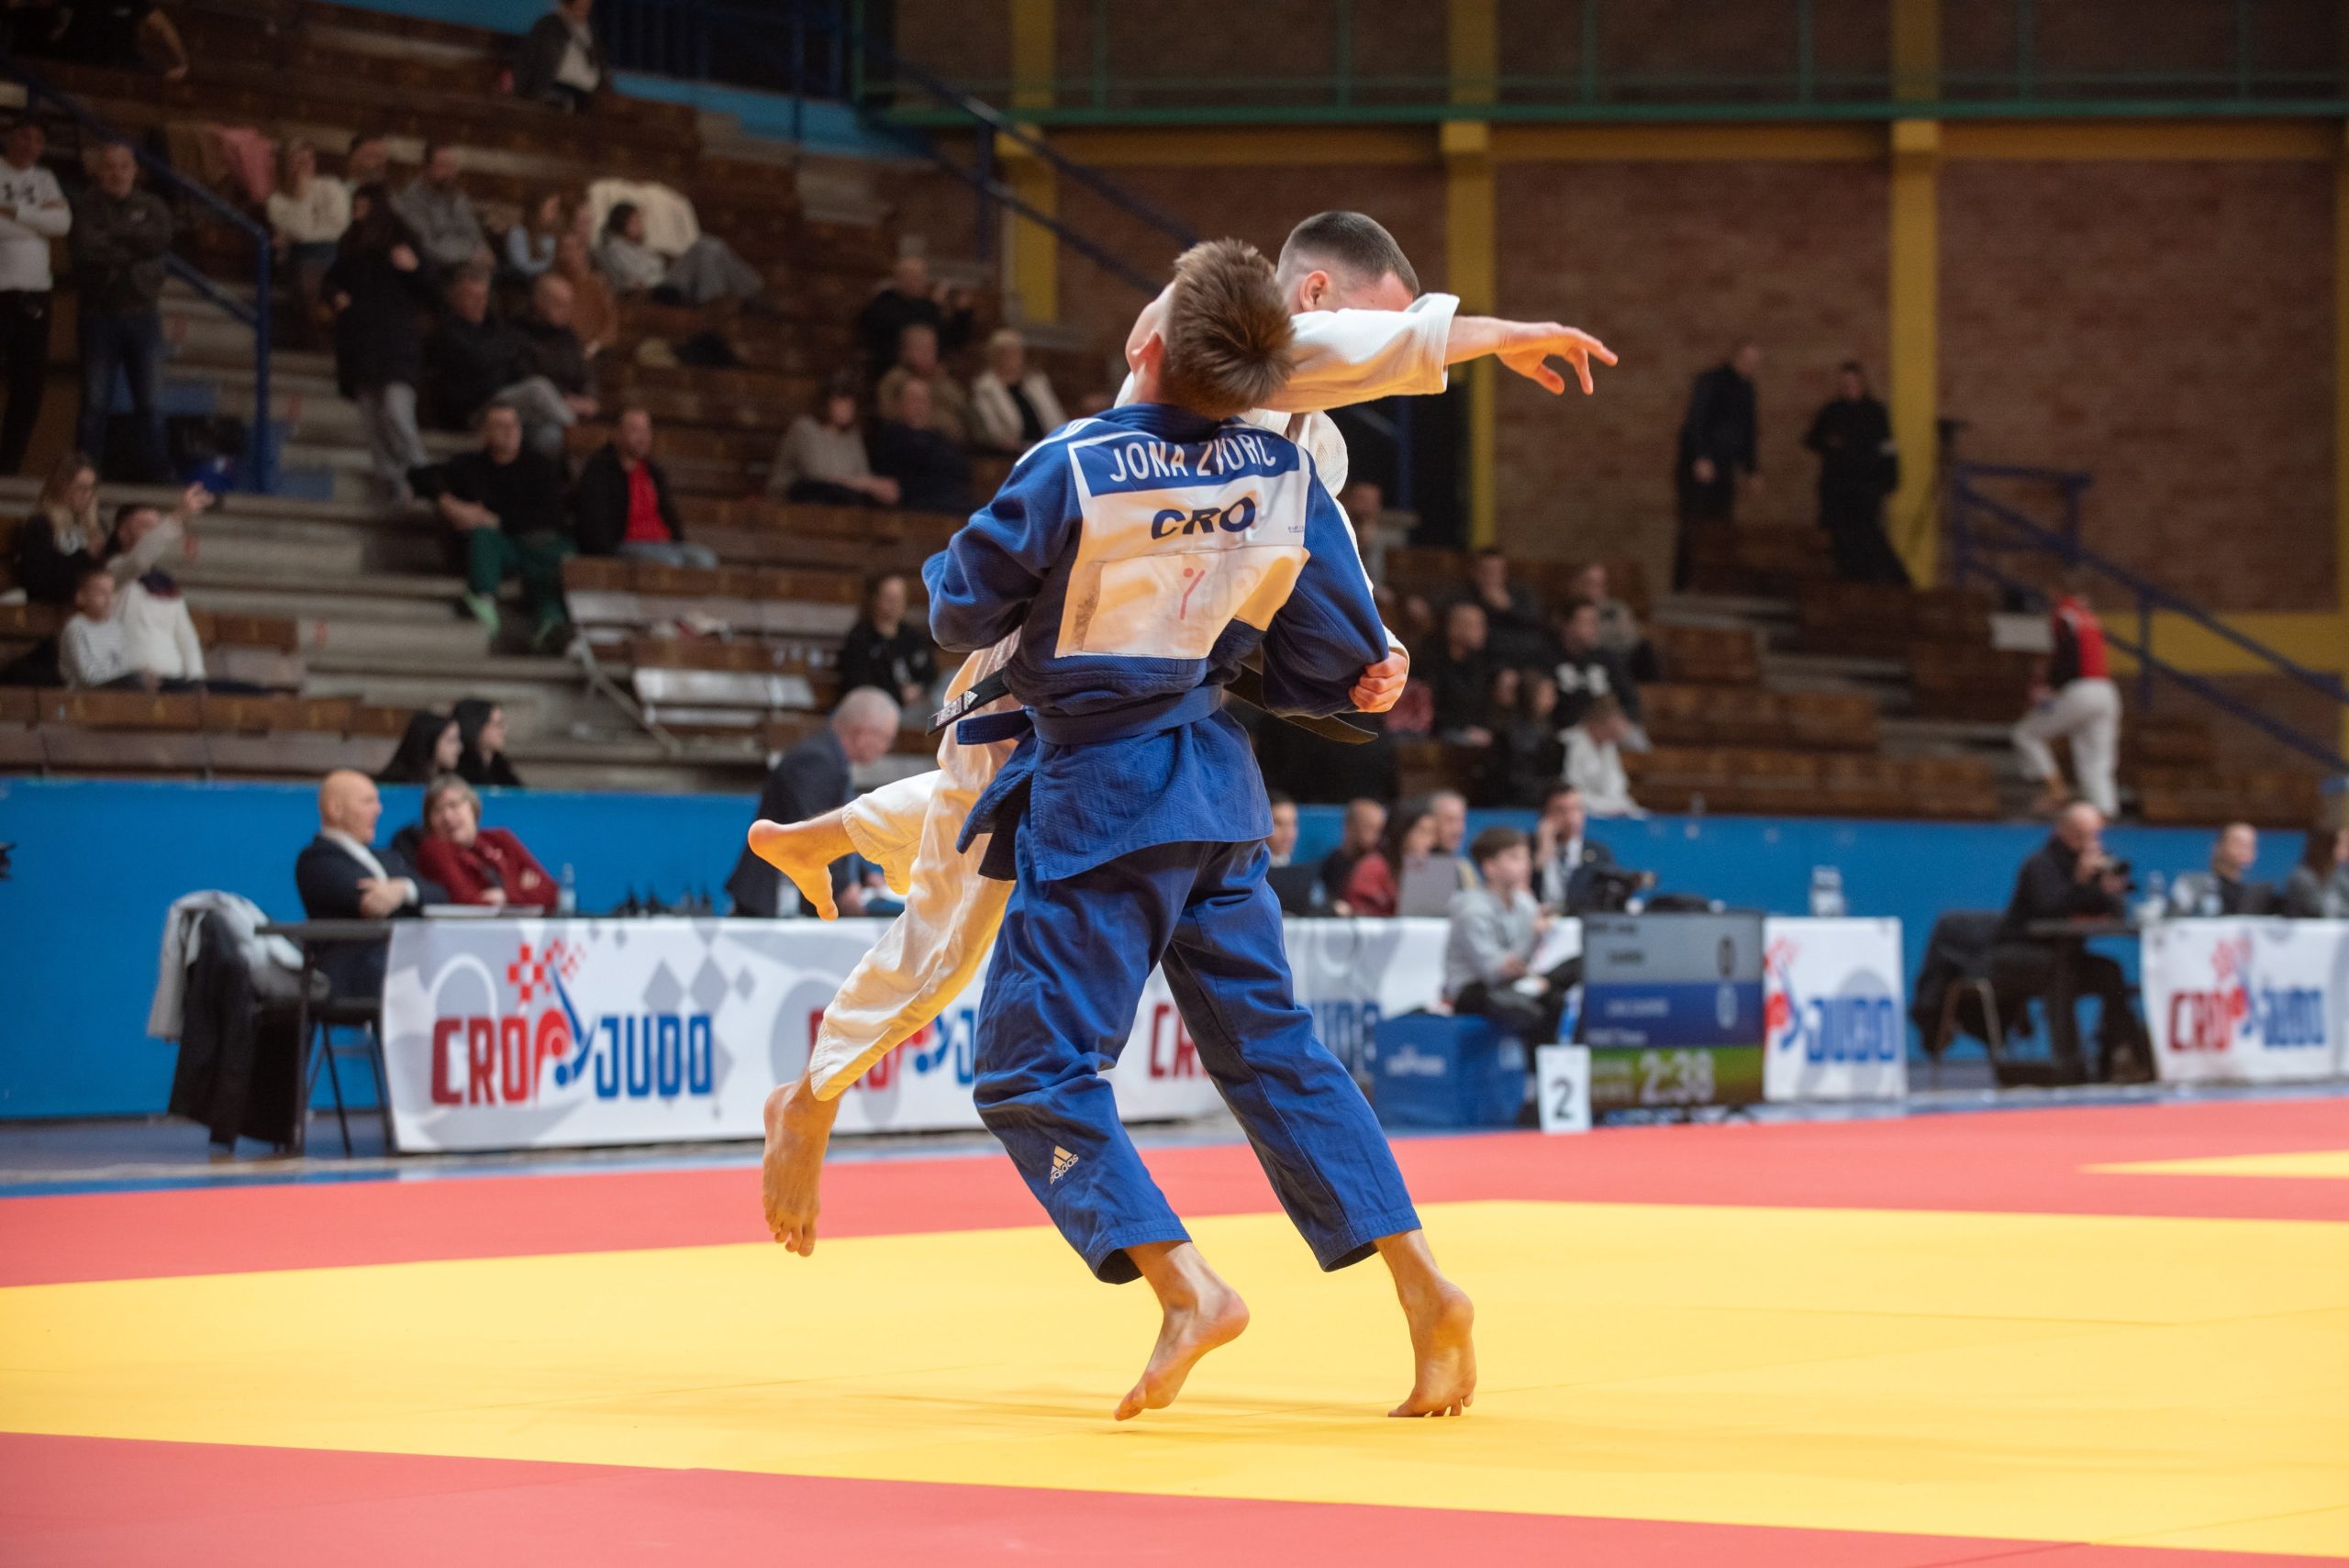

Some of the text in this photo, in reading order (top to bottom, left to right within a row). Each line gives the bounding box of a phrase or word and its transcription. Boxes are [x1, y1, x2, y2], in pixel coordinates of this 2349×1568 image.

[1109, 440, 1189, 483] JONA
[1151, 495, 1256, 540] CRO
[1807, 996, 1897, 1063] JUDO
[430, 1017, 529, 1106] CRO
[595, 1014, 712, 1098] JUDO
[1552, 1077, 1574, 1120] 2
[1050, 1153, 1079, 1184] adidas
